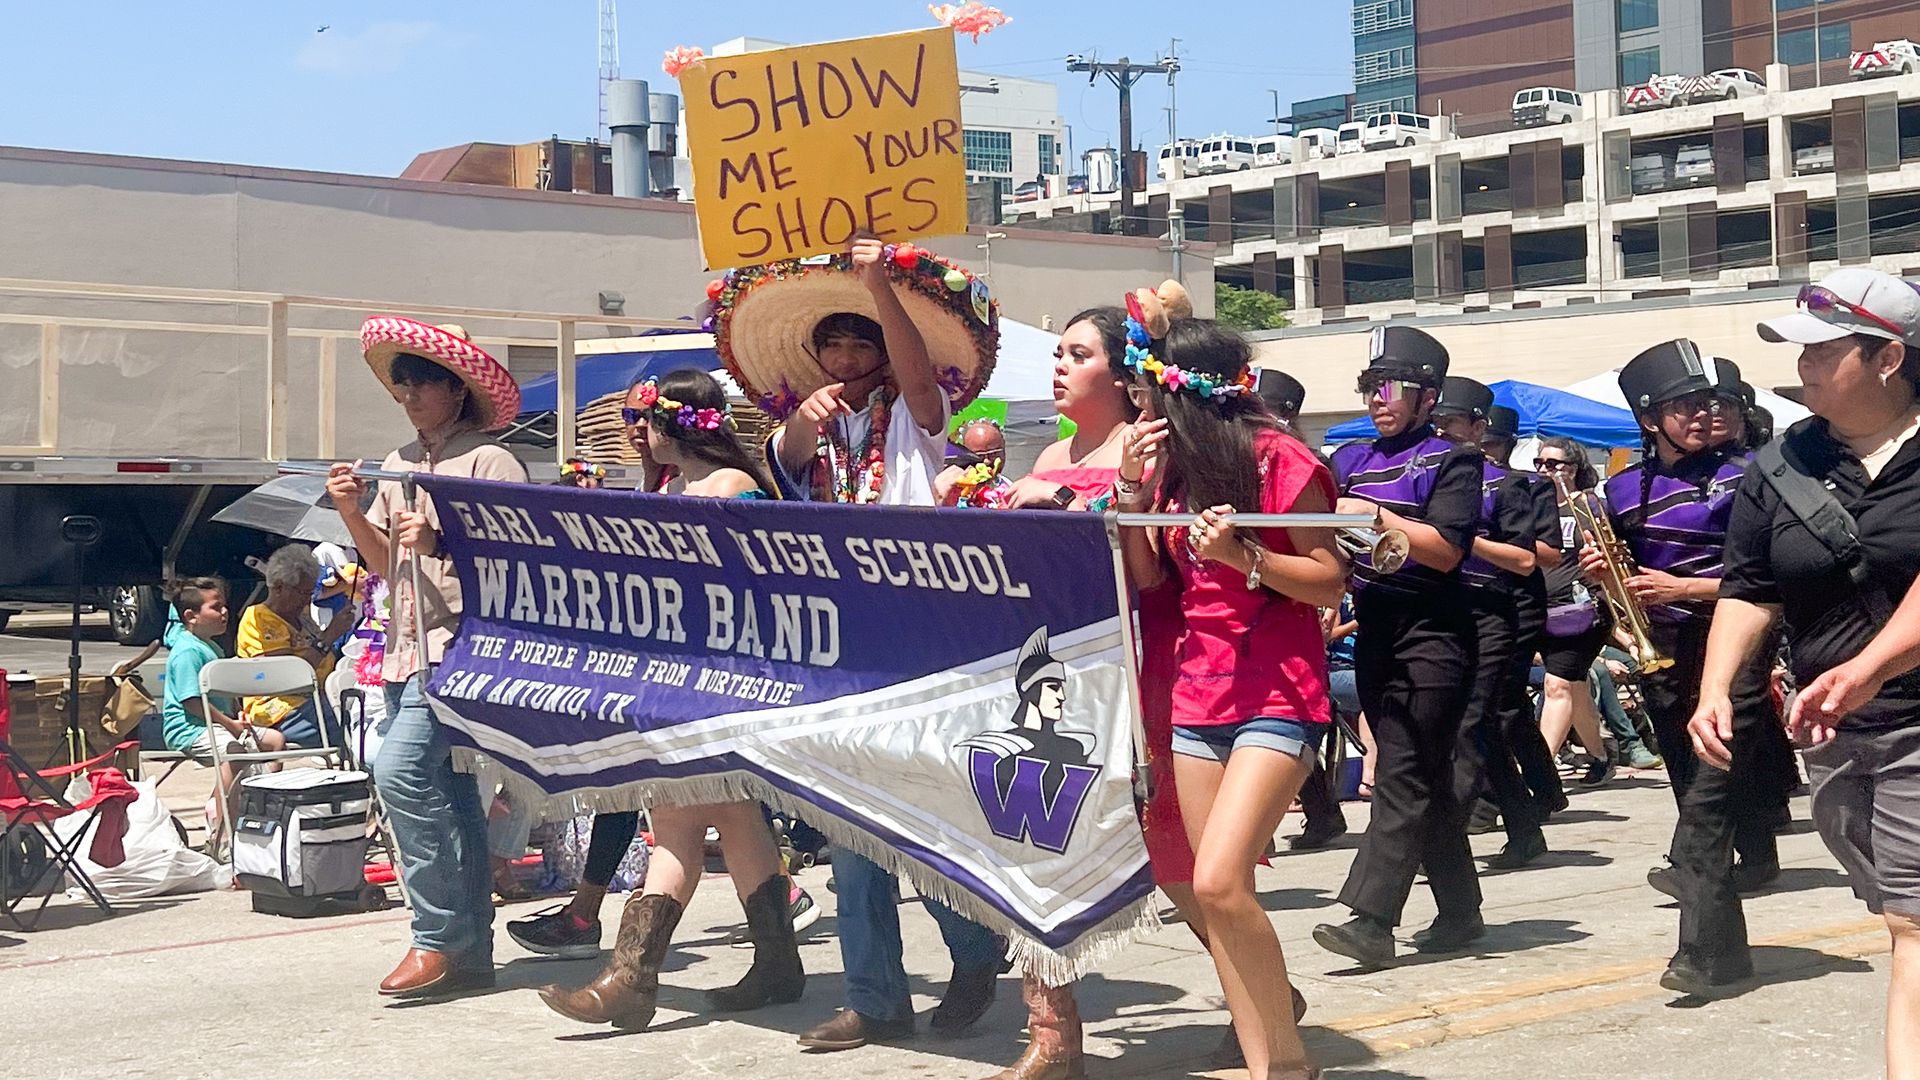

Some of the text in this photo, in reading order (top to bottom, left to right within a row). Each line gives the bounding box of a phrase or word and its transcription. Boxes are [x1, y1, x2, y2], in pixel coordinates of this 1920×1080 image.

[710, 43, 926, 142] SHOW
[719, 119, 959, 199] ME YOUR
[732, 177, 938, 258] SHOES
[448, 501, 556, 547] EARL
[552, 510, 723, 568] WARREN
[844, 536, 1031, 598] SCHOOL
[474, 556, 841, 668] WARRIOR BAND
[438, 670, 637, 724] SAN ANTONIO, TX
[508, 639, 578, 669] PURPLE
[582, 649, 639, 678] PRIDE
[641, 659, 692, 688] FROM
[693, 667, 804, 706] NORTHSIDE"
